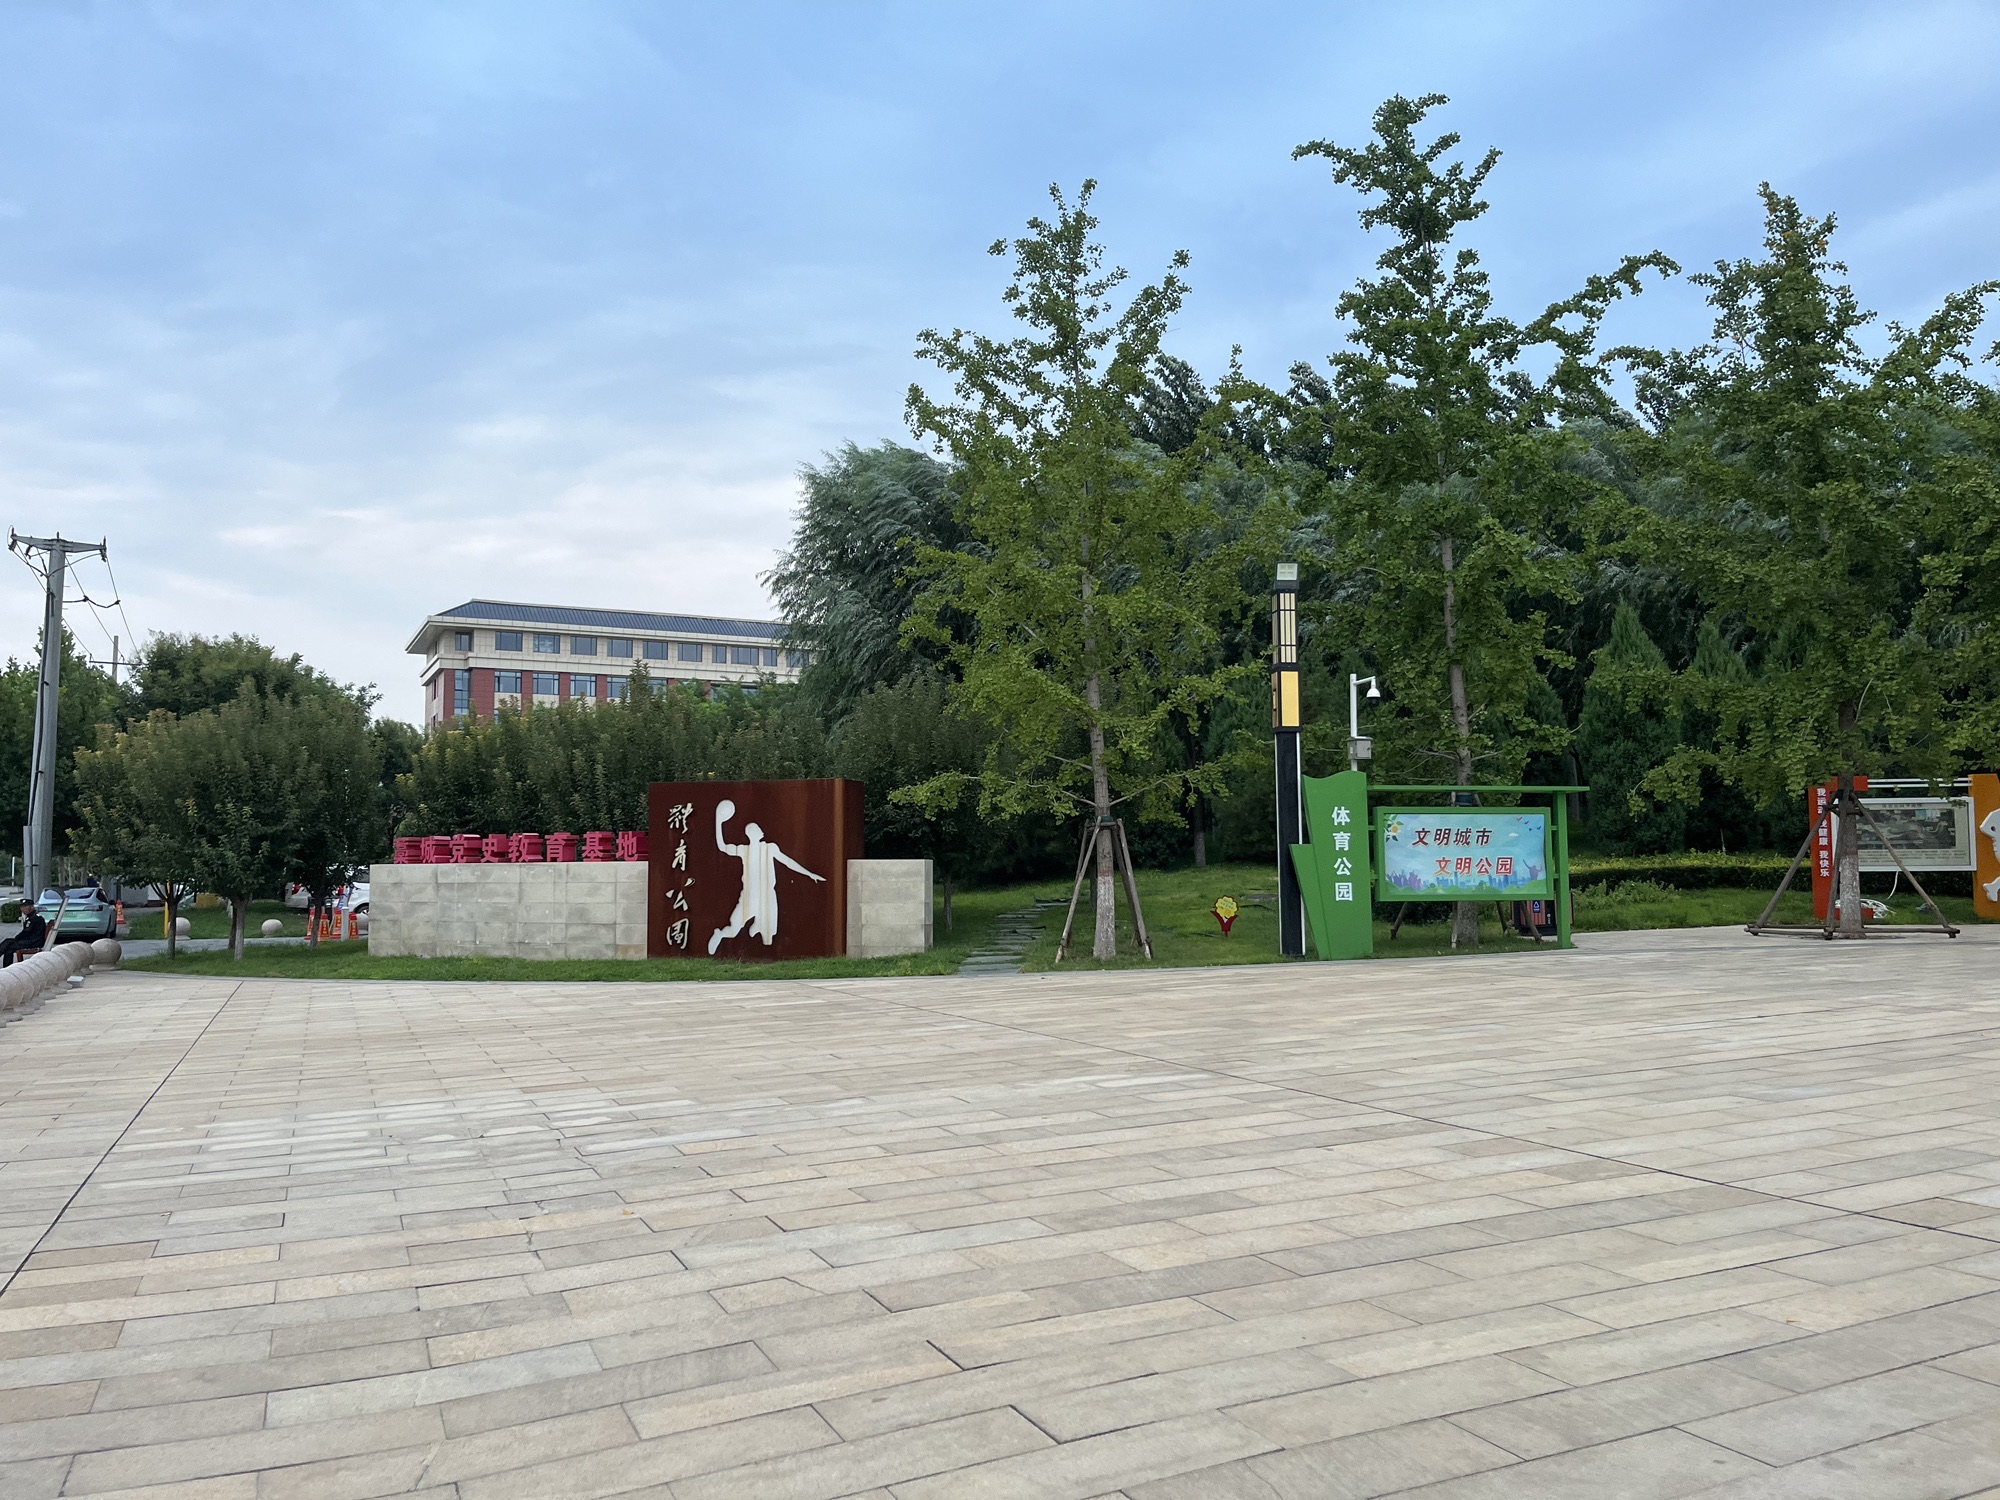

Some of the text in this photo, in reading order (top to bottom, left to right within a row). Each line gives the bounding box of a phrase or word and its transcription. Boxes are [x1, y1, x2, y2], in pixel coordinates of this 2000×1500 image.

[1412, 827, 1493, 847] 文明城市
[1332, 806, 1353, 902] 体育公园
[1434, 856, 1514, 876] 文明公园
